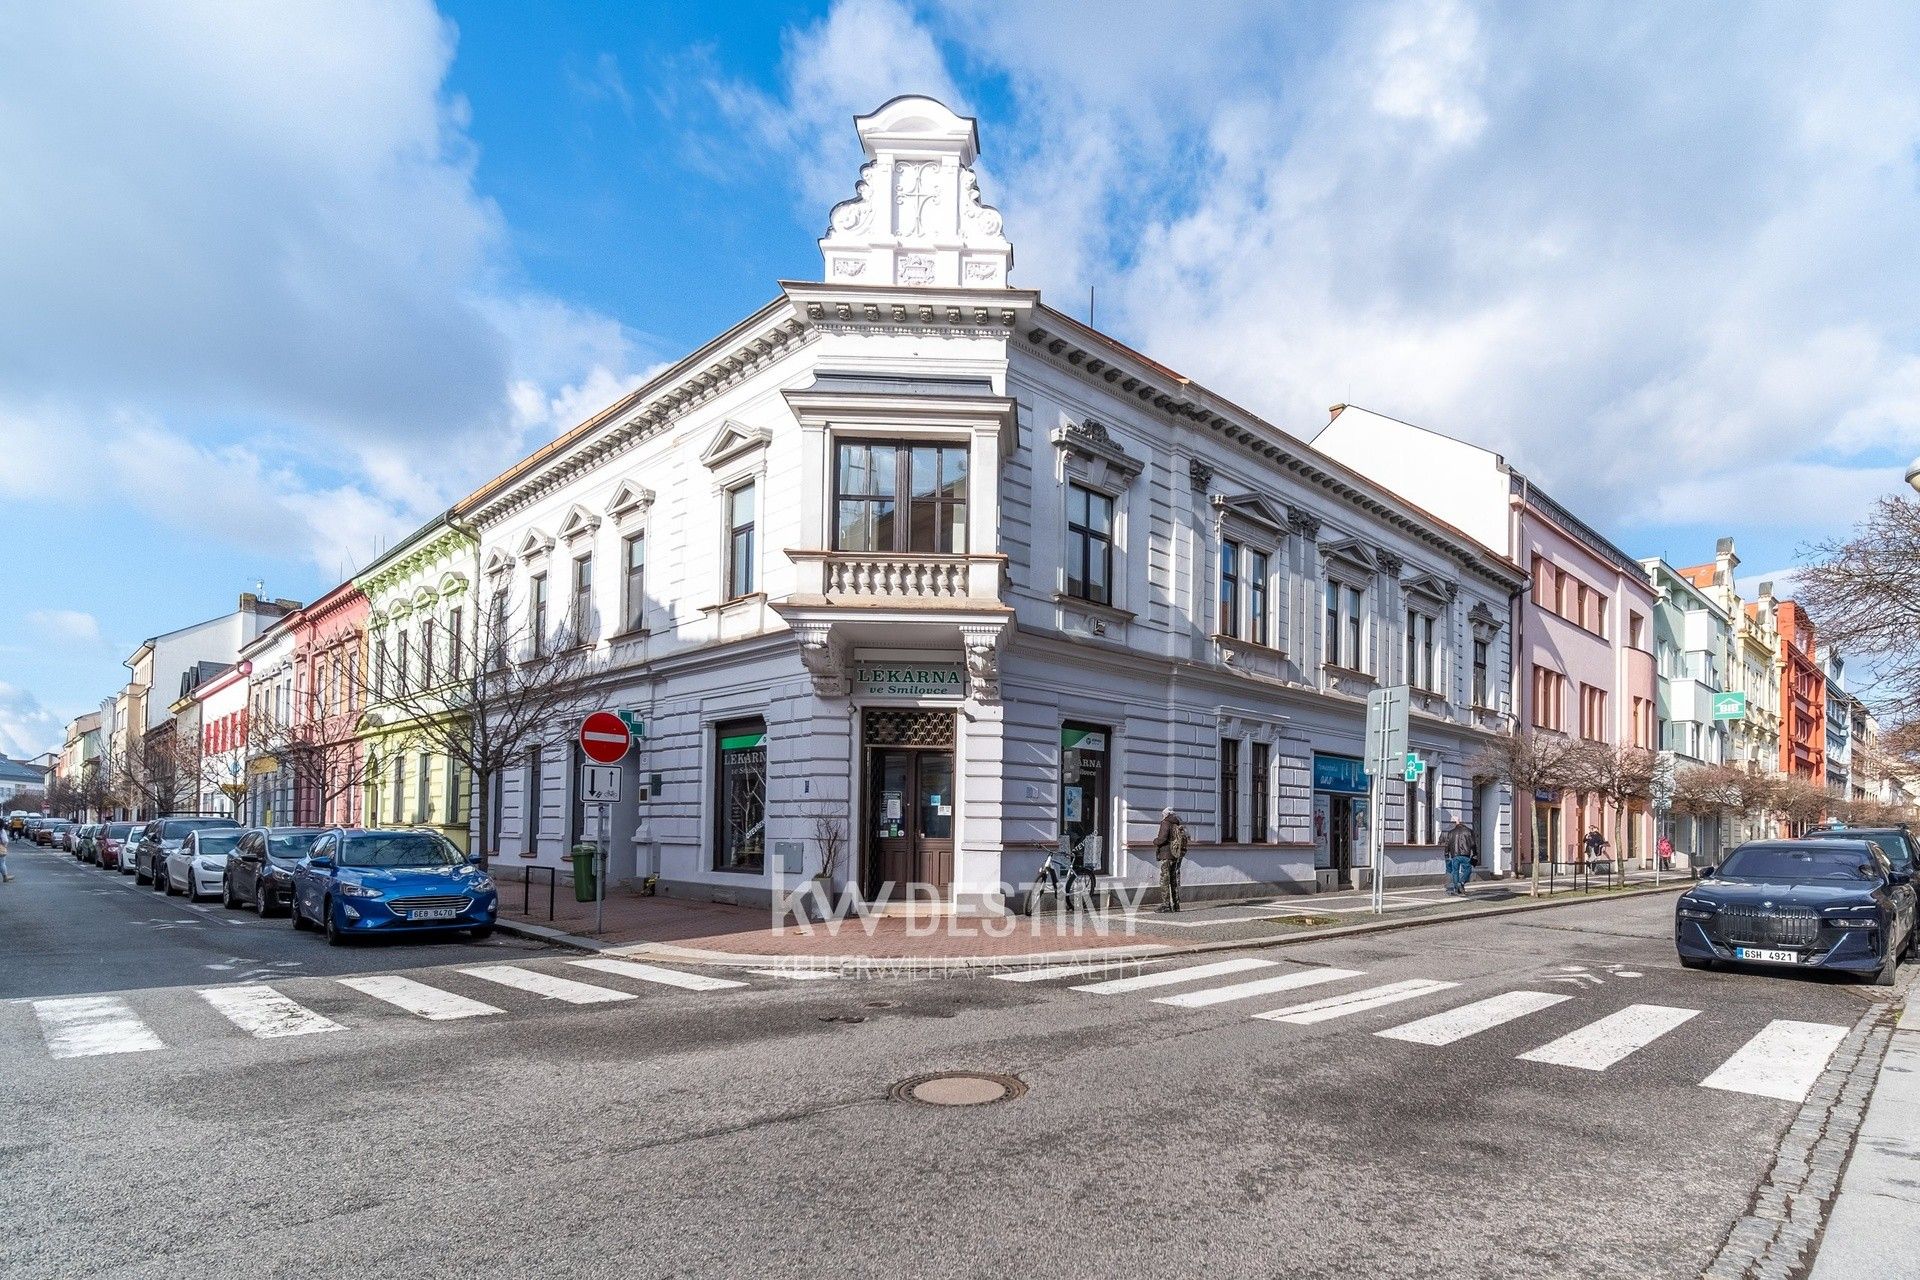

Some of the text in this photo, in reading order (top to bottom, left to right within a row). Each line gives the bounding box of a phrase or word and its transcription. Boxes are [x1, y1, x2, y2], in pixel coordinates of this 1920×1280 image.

[858, 665, 961, 684] LÉKÁRNA
[888, 685, 948, 695] Smilovce
[724, 749, 767, 766] LÉKÁRN
[434, 908, 453, 917] 8470
[1744, 949, 1792, 961] 6SH 4921
